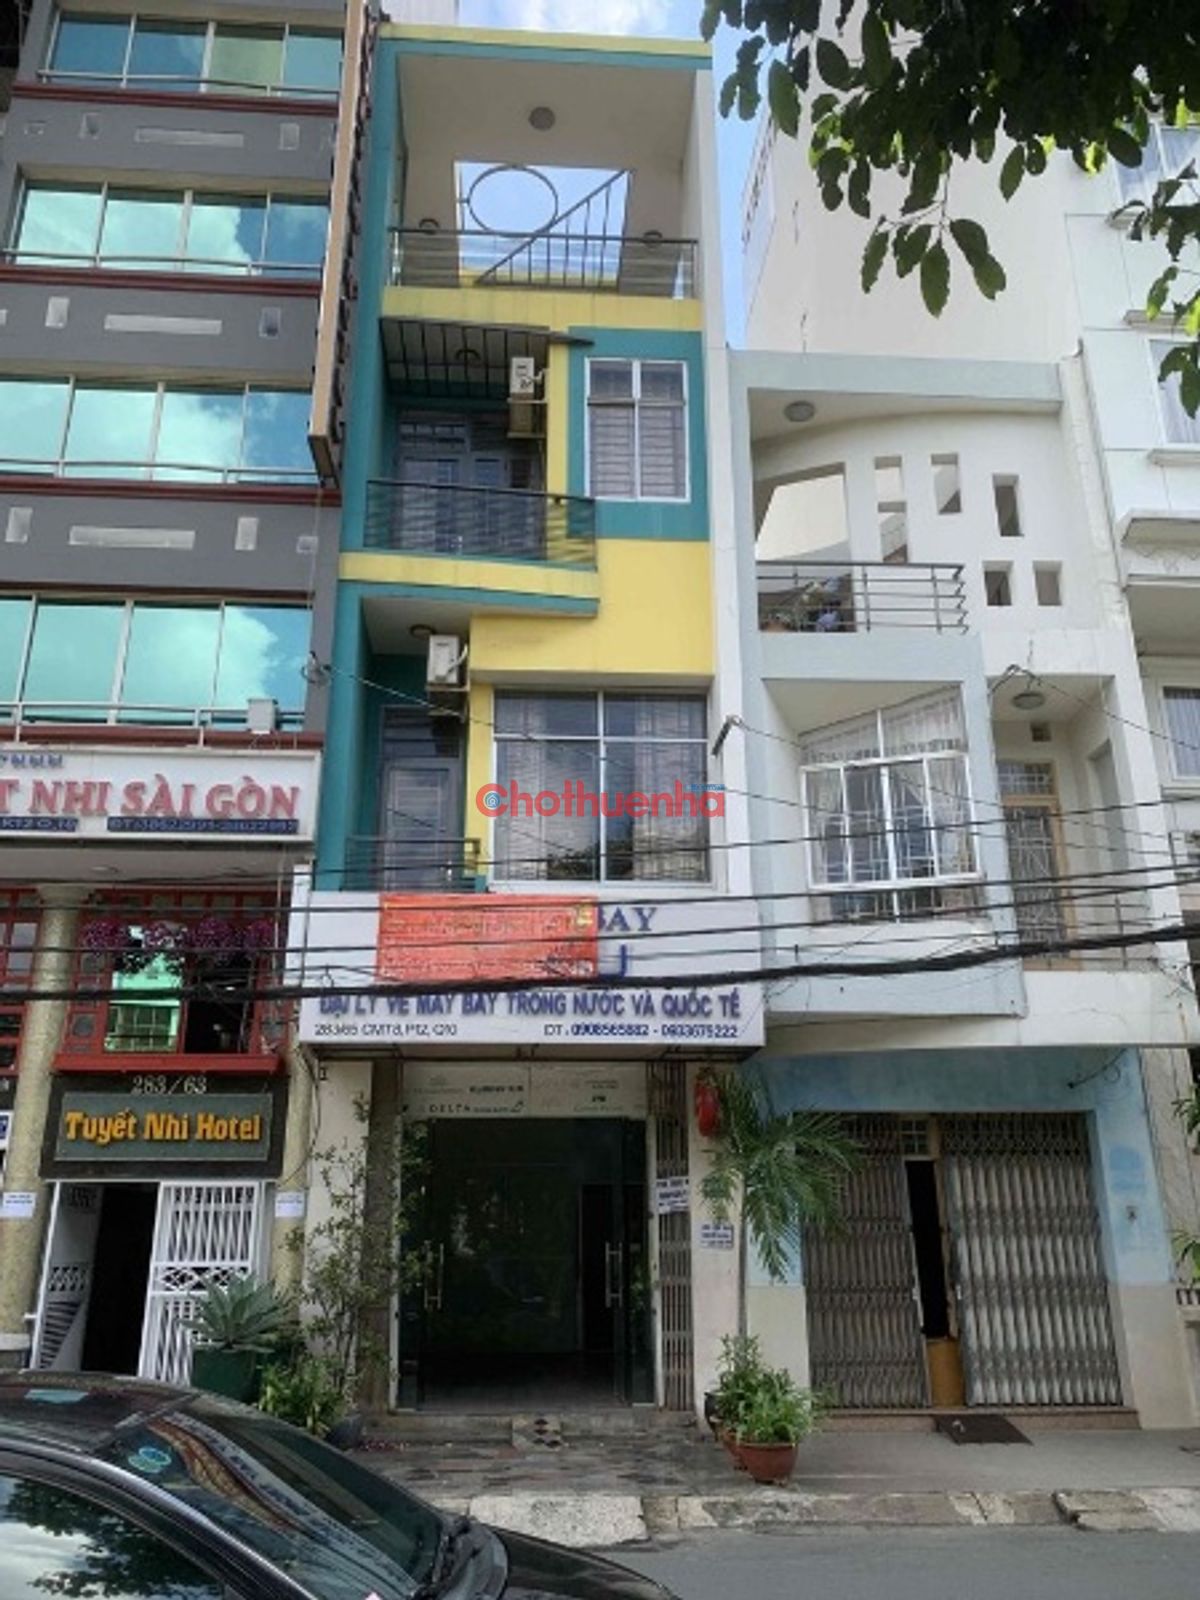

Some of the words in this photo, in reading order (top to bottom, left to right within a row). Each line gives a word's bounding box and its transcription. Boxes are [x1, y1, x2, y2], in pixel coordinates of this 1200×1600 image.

[29, 779, 111, 816] NHI
[120, 774, 196, 818] SÀI
[206, 776, 300, 820] GÒN
[506, 990, 567, 1017] TRONG
[65, 1107, 138, 1145] Tuyết
[143, 1113, 189, 1141] Nhi
[194, 1113, 262, 1141] Hotel
